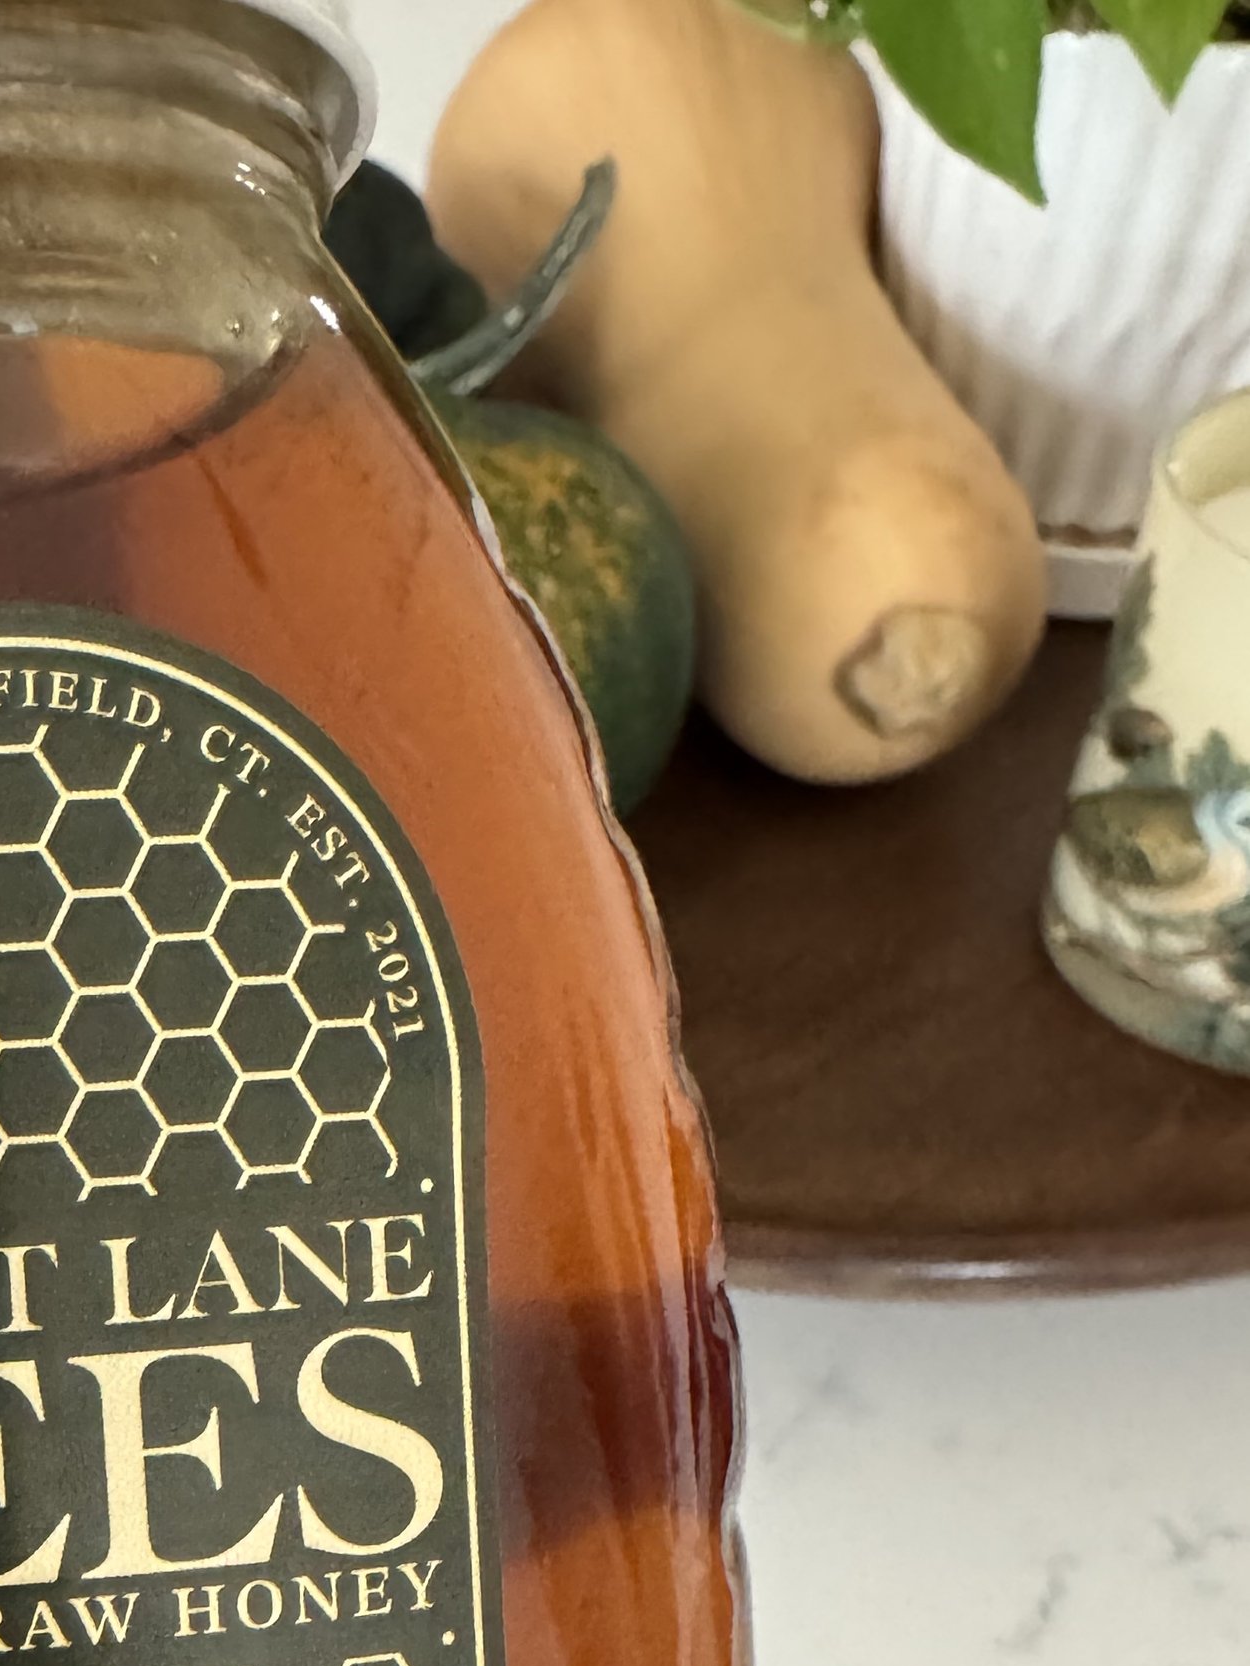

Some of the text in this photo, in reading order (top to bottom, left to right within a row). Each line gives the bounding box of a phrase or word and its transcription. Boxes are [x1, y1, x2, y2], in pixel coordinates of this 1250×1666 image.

[199, 724, 271, 798] CT.
[285, 793, 369, 909] EST.
[364, 919, 426, 1044] 2021
[99, 1213, 435, 1328] LANE
[172, 1558, 444, 1639] HONEY
